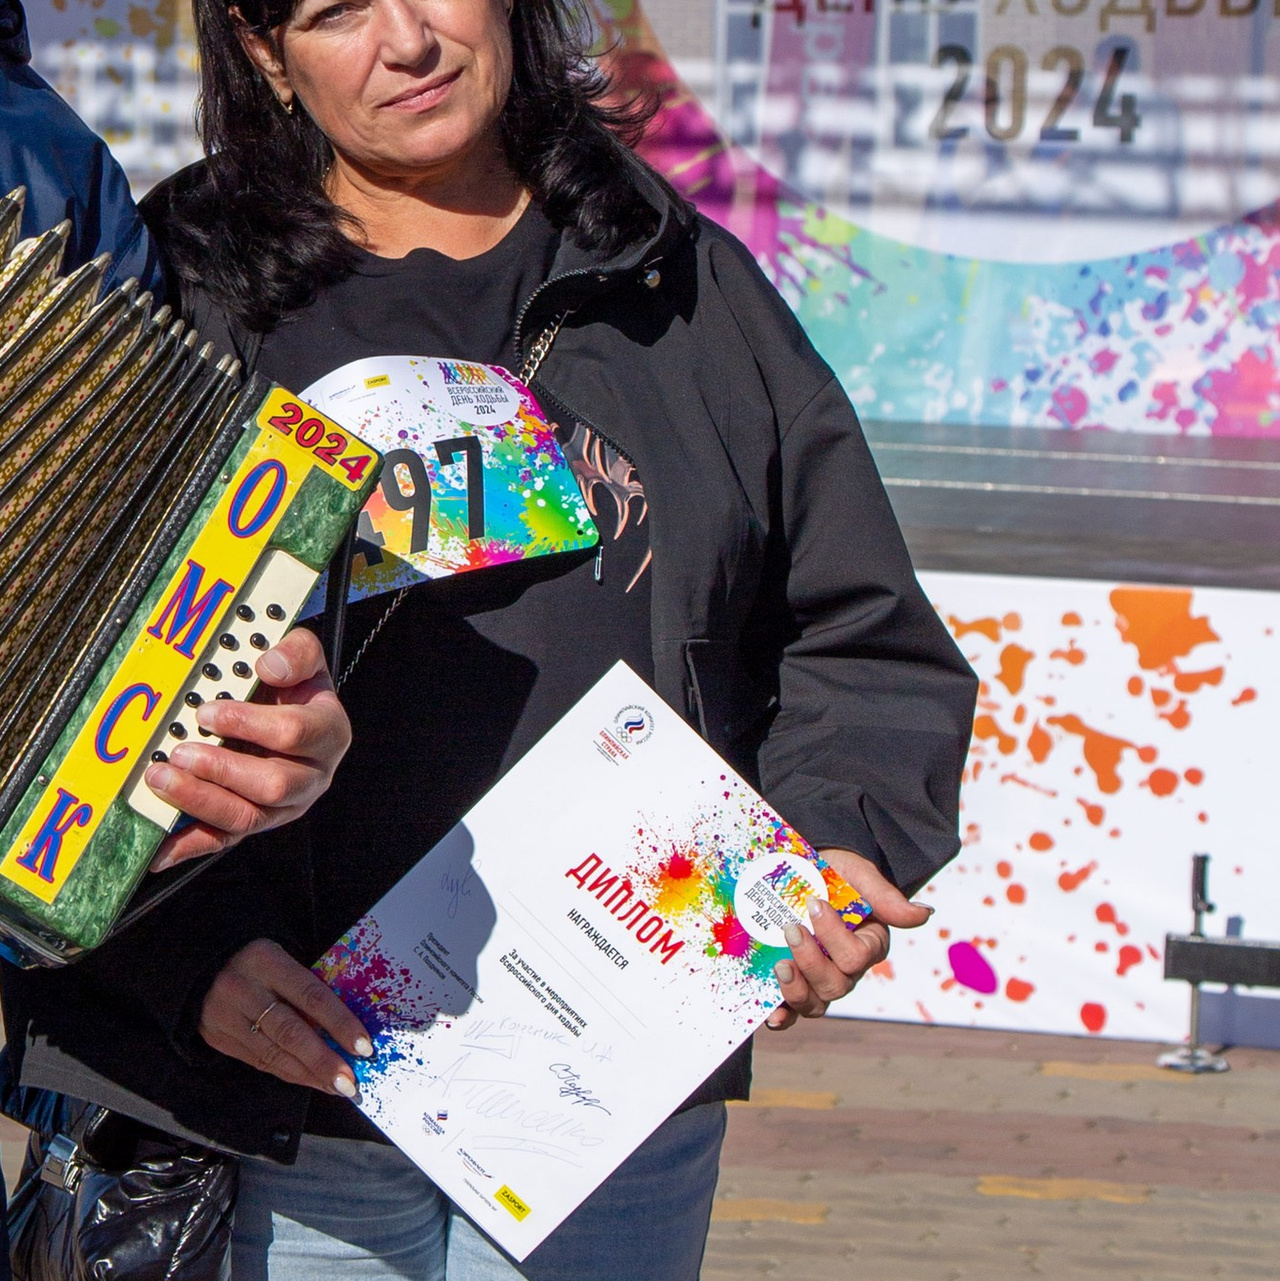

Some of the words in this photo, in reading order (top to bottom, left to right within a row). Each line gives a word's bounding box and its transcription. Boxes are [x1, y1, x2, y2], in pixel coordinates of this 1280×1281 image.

[929, 45, 1142, 143] 2024
[450, 394, 474, 407] ДЕНЬ
[474, 393, 509, 404] ХОДЬБЫ
[474, 404, 496, 415] 2024
[268, 402, 373, 484] 2024
[16, 458, 288, 884] ОМСК
[565, 852, 685, 965] ДИПЛОМ
[744, 887, 765, 909] ДЕНЬ
[751, 910, 771, 931] 2024
[567, 908, 629, 970] НАГРАЖДАЕТСЯ
[499, 954, 547, 1004] Всероссийского
[545, 1001, 559, 1016] дня
[558, 1012, 582, 1038] ходьбы
[508, 948, 518, 961] За
[515, 956, 542, 984] участие
[545, 985, 588, 1029] мероприятиях
[501, 1189, 526, 1213] ZASPORT
